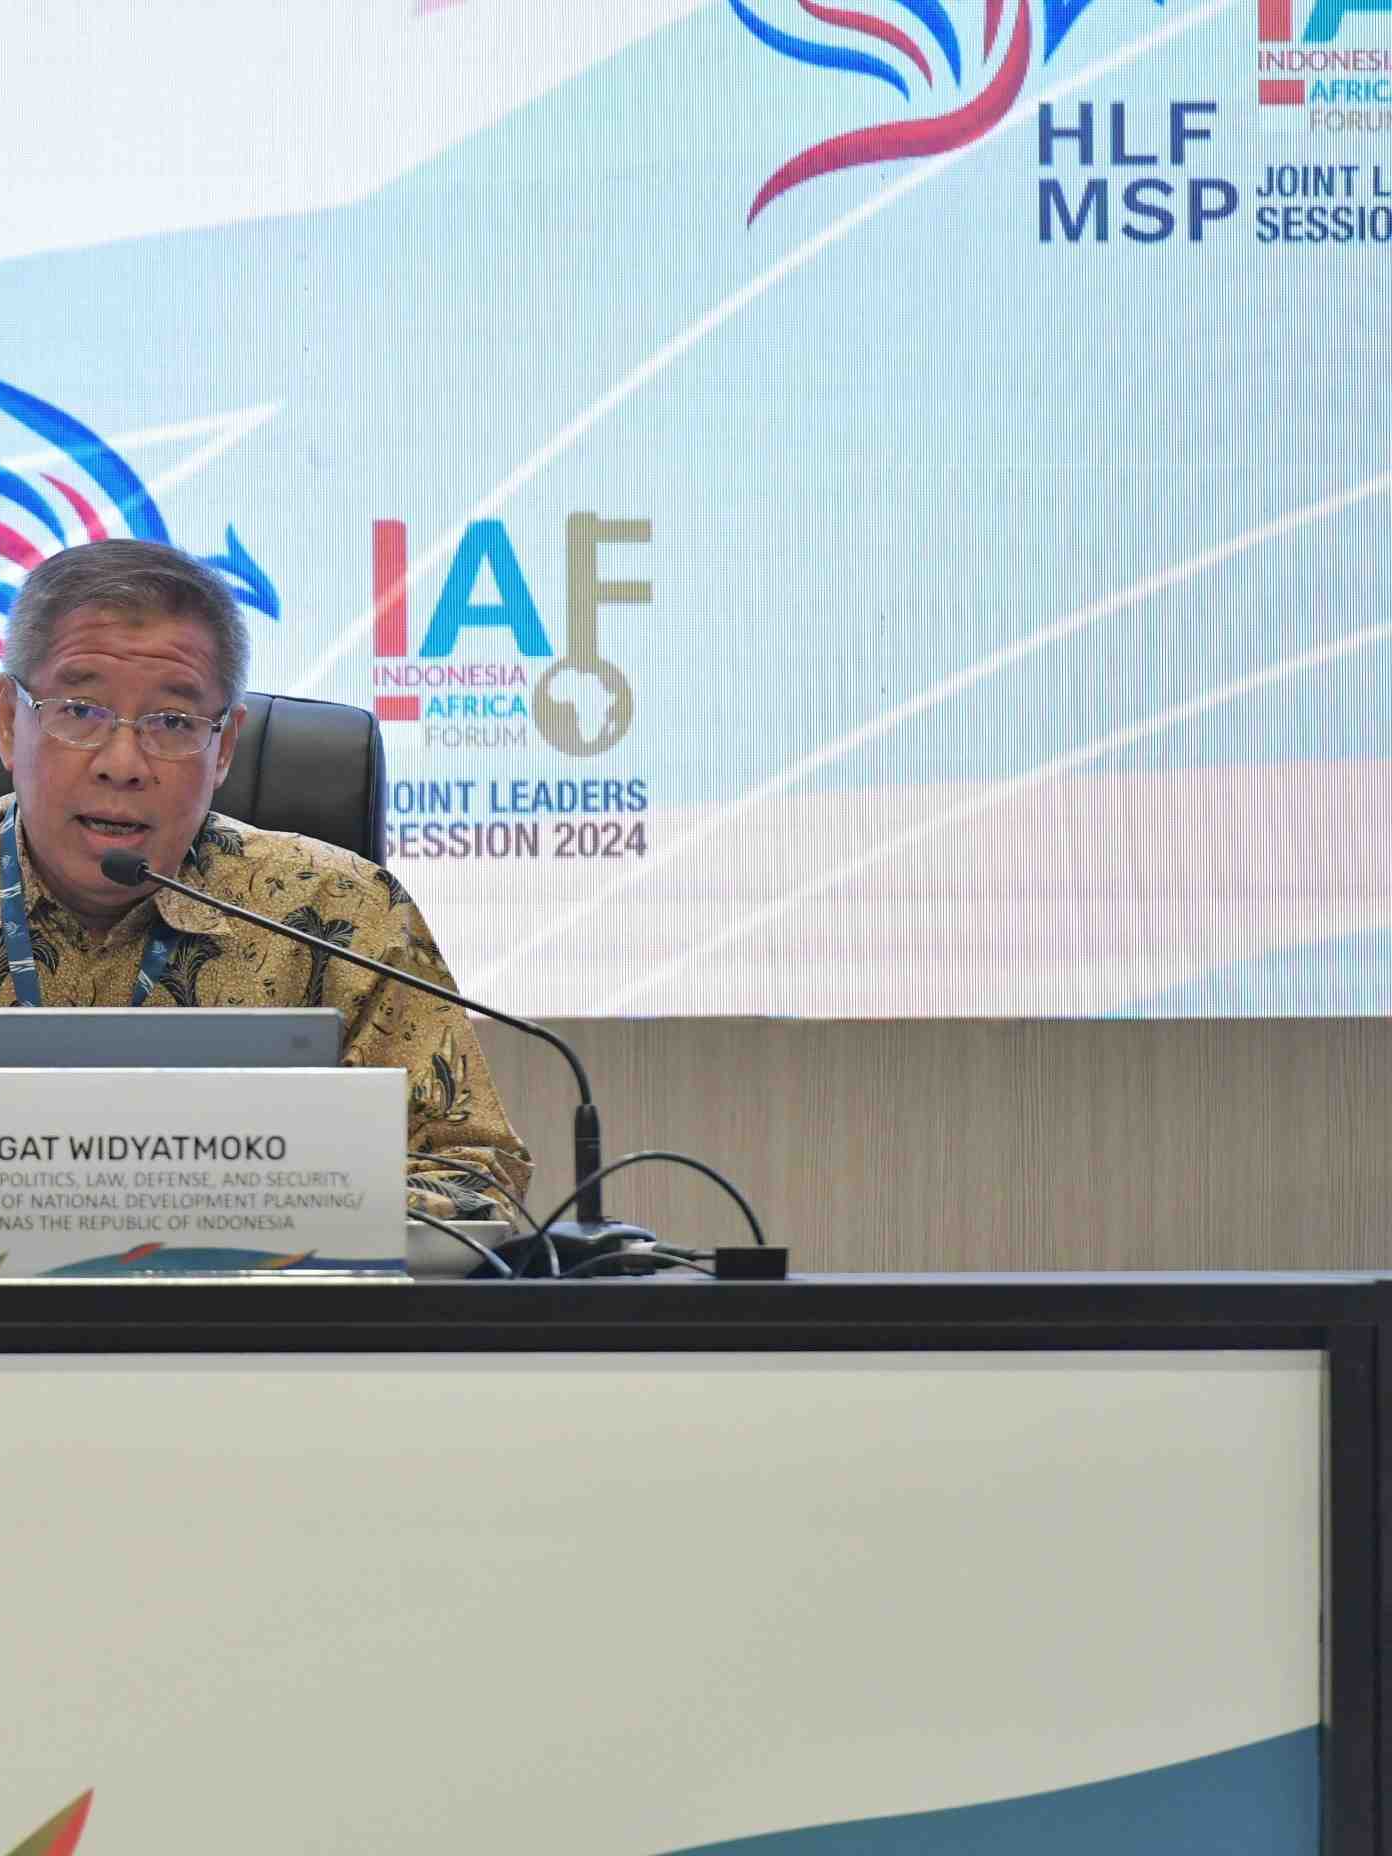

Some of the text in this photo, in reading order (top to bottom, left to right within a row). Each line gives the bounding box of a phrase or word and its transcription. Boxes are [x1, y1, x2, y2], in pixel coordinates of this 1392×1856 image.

[1258, 50, 1392, 72] INDONESI
[1310, 79, 1392, 103] AFRIC
[1039, 102, 1217, 166] HLF
[1257, 165, 1360, 198] JOINT
[1039, 178, 1239, 243] MSP
[373, 512, 652, 657] IAF
[374, 664, 527, 687] INDONESIA
[426, 695, 527, 718] AFRICA
[426, 724, 527, 748] FORUM
[386, 778, 648, 813] OINT LEADERS
[555, 821, 647, 858] 2024
[69, 1136, 287, 1161] WIDYATMOKO
[0, 1172, 81, 1190] POLITICS,
[86, 1172, 128, 1191] LAW,
[223, 1172, 260, 1188] AND
[1, 1193, 24, 1209] OF
[31, 1193, 120, 1209] NATIONAL
[126, 1193, 257, 1209] DEVELOPMENT
[264, 1192, 365, 1211] PLANNING/
[40, 1215, 72, 1231] THE
[80, 1215, 161, 1231] REPUBLIC
[167, 1215, 191, 1231] OF
[196, 1215, 295, 1231] INDONESIA
